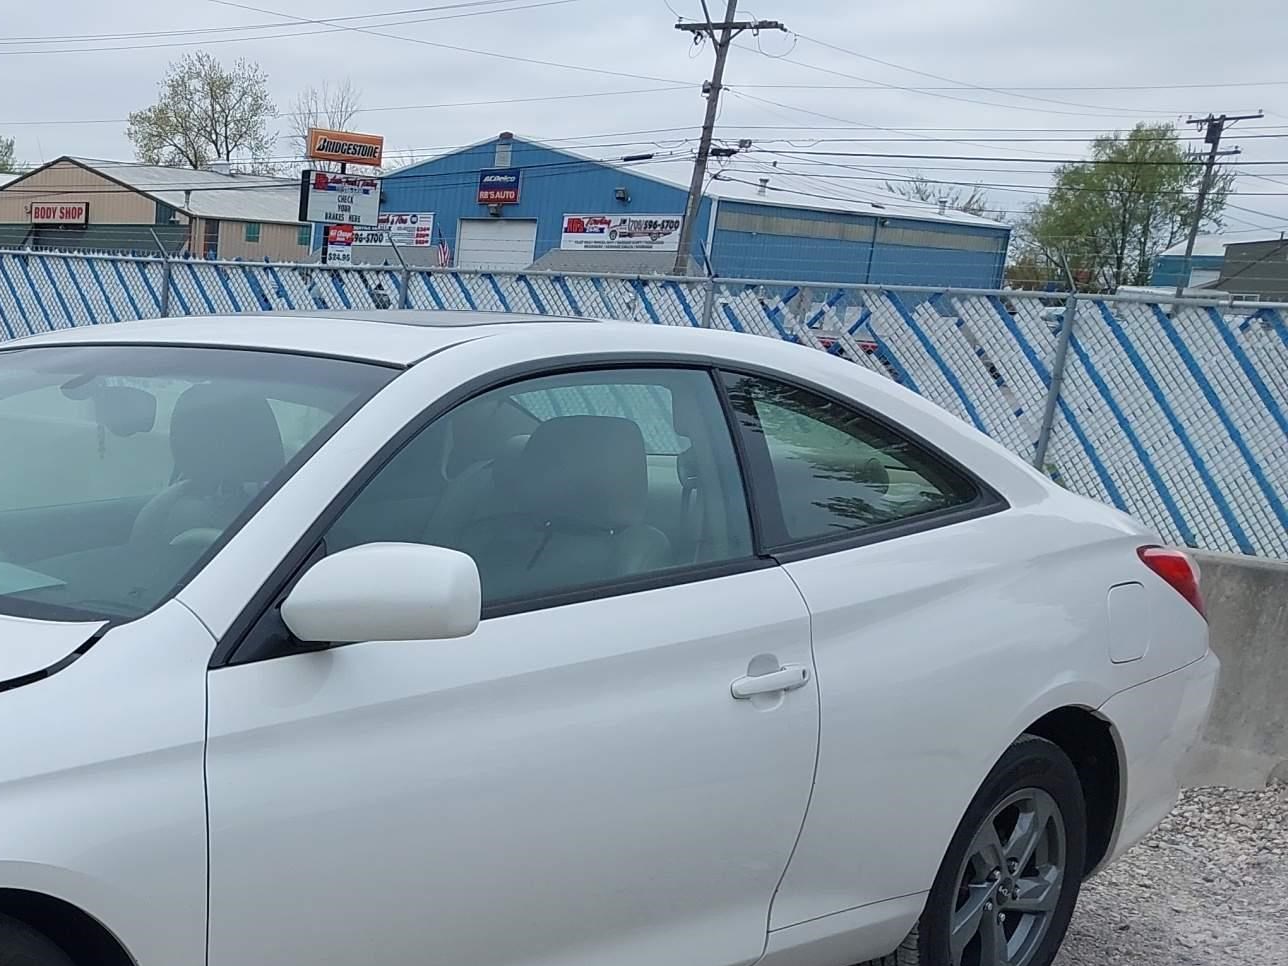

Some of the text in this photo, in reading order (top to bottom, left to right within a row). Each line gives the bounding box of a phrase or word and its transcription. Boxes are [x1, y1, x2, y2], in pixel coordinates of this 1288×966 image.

[316, 137, 379, 158] BRIDGESTONE
[338, 195, 353, 204] CHECK
[494, 191, 516, 199] AUTO
[34, 206, 83, 219] BODY SHOP
[338, 204, 351, 212] YOUR
[324, 212, 345, 221] BRAKES
[328, 252, 351, 262] $24.95
